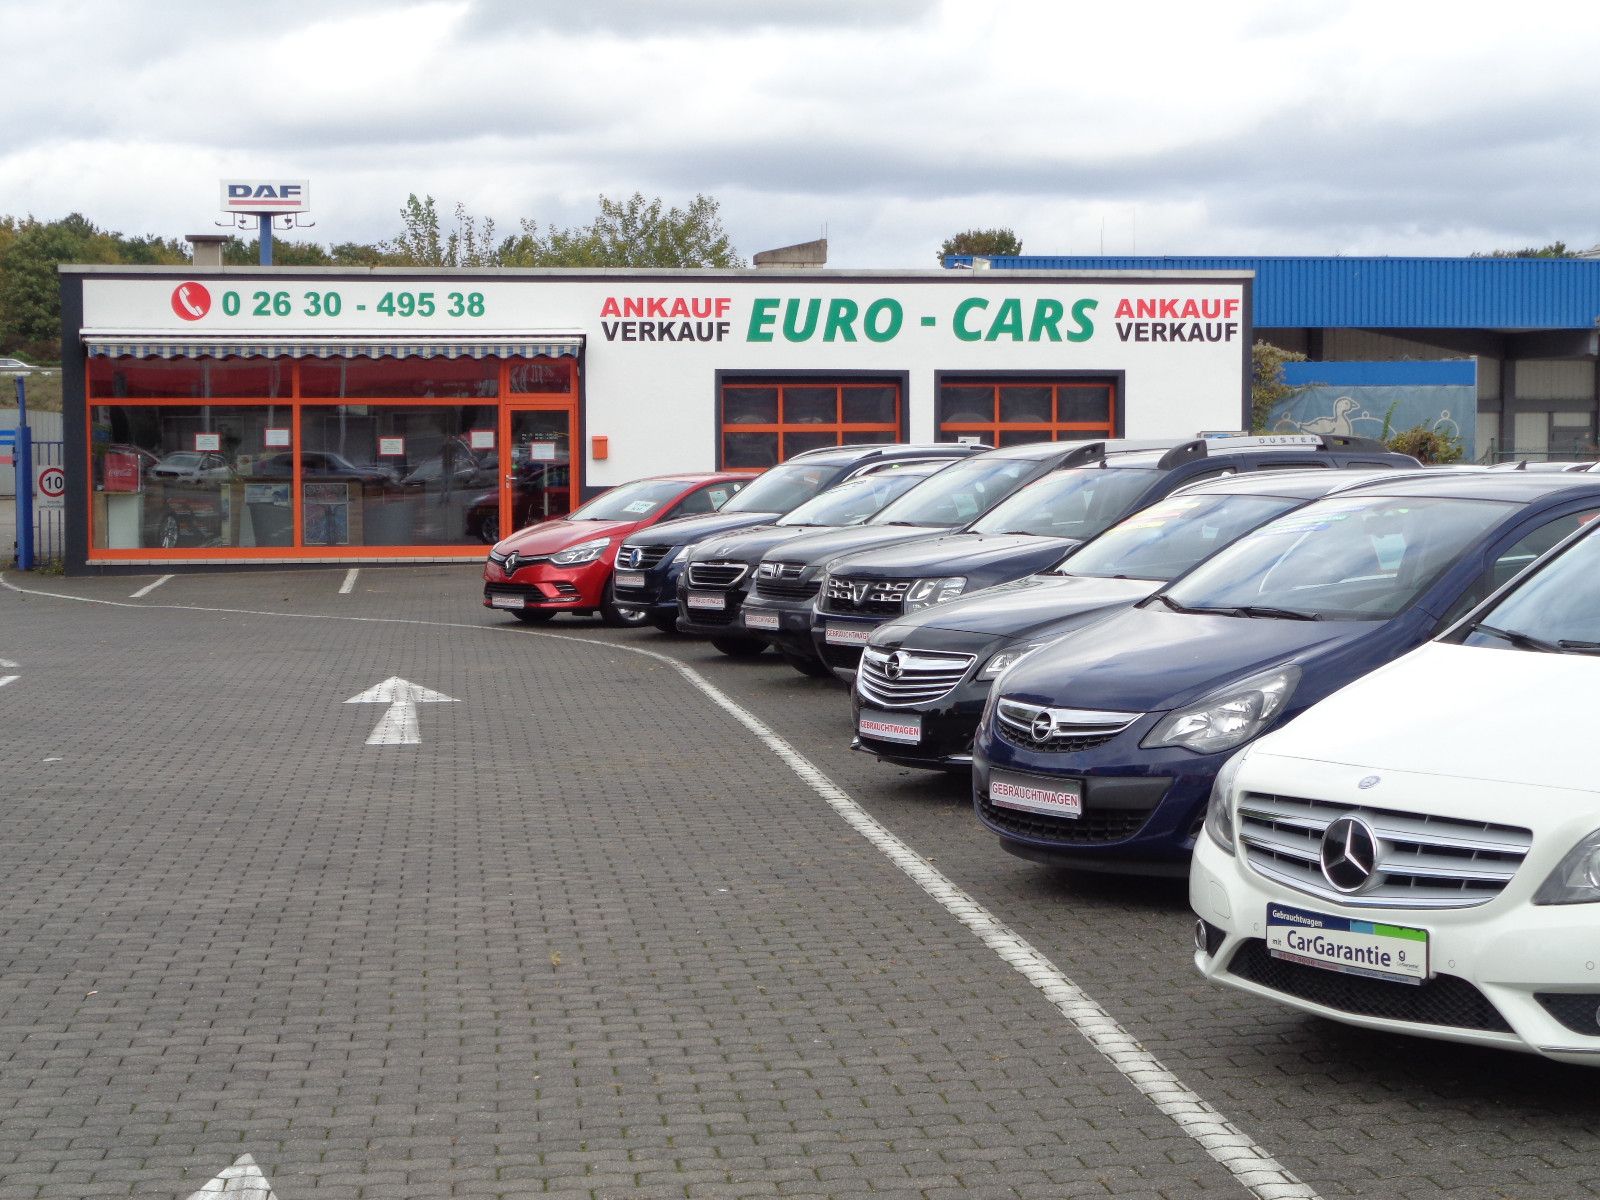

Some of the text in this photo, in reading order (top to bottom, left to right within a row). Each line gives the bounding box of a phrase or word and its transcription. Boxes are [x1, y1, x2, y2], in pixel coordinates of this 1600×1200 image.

[228, 184, 302, 199] DAF
[222, 290, 241, 317] 0
[252, 290, 292, 317] 26
[303, 291, 342, 318] 30
[376, 291, 436, 318] 495
[447, 291, 486, 318] 38
[599, 296, 732, 319] ANKAUF
[1114, 298, 1240, 320] ANKAUF
[745, 297, 904, 343] EURO
[952, 296, 1099, 343] CARS
[600, 321, 731, 342] VERKAUF
[1115, 322, 1239, 343] VERKAUF
[1259, 436, 1317, 444] DUSTER
[45, 476, 63, 490] 10
[826, 629, 870, 640] GEBRAUCHTWAGE
[860, 720, 919, 736] GEBRAUCHTWAGEN
[992, 782, 1078, 807] GEBRAUCHTWAGEN
[1272, 909, 1323, 928] Gebrauchtwagen
[1286, 929, 1391, 968] CarGarantie
